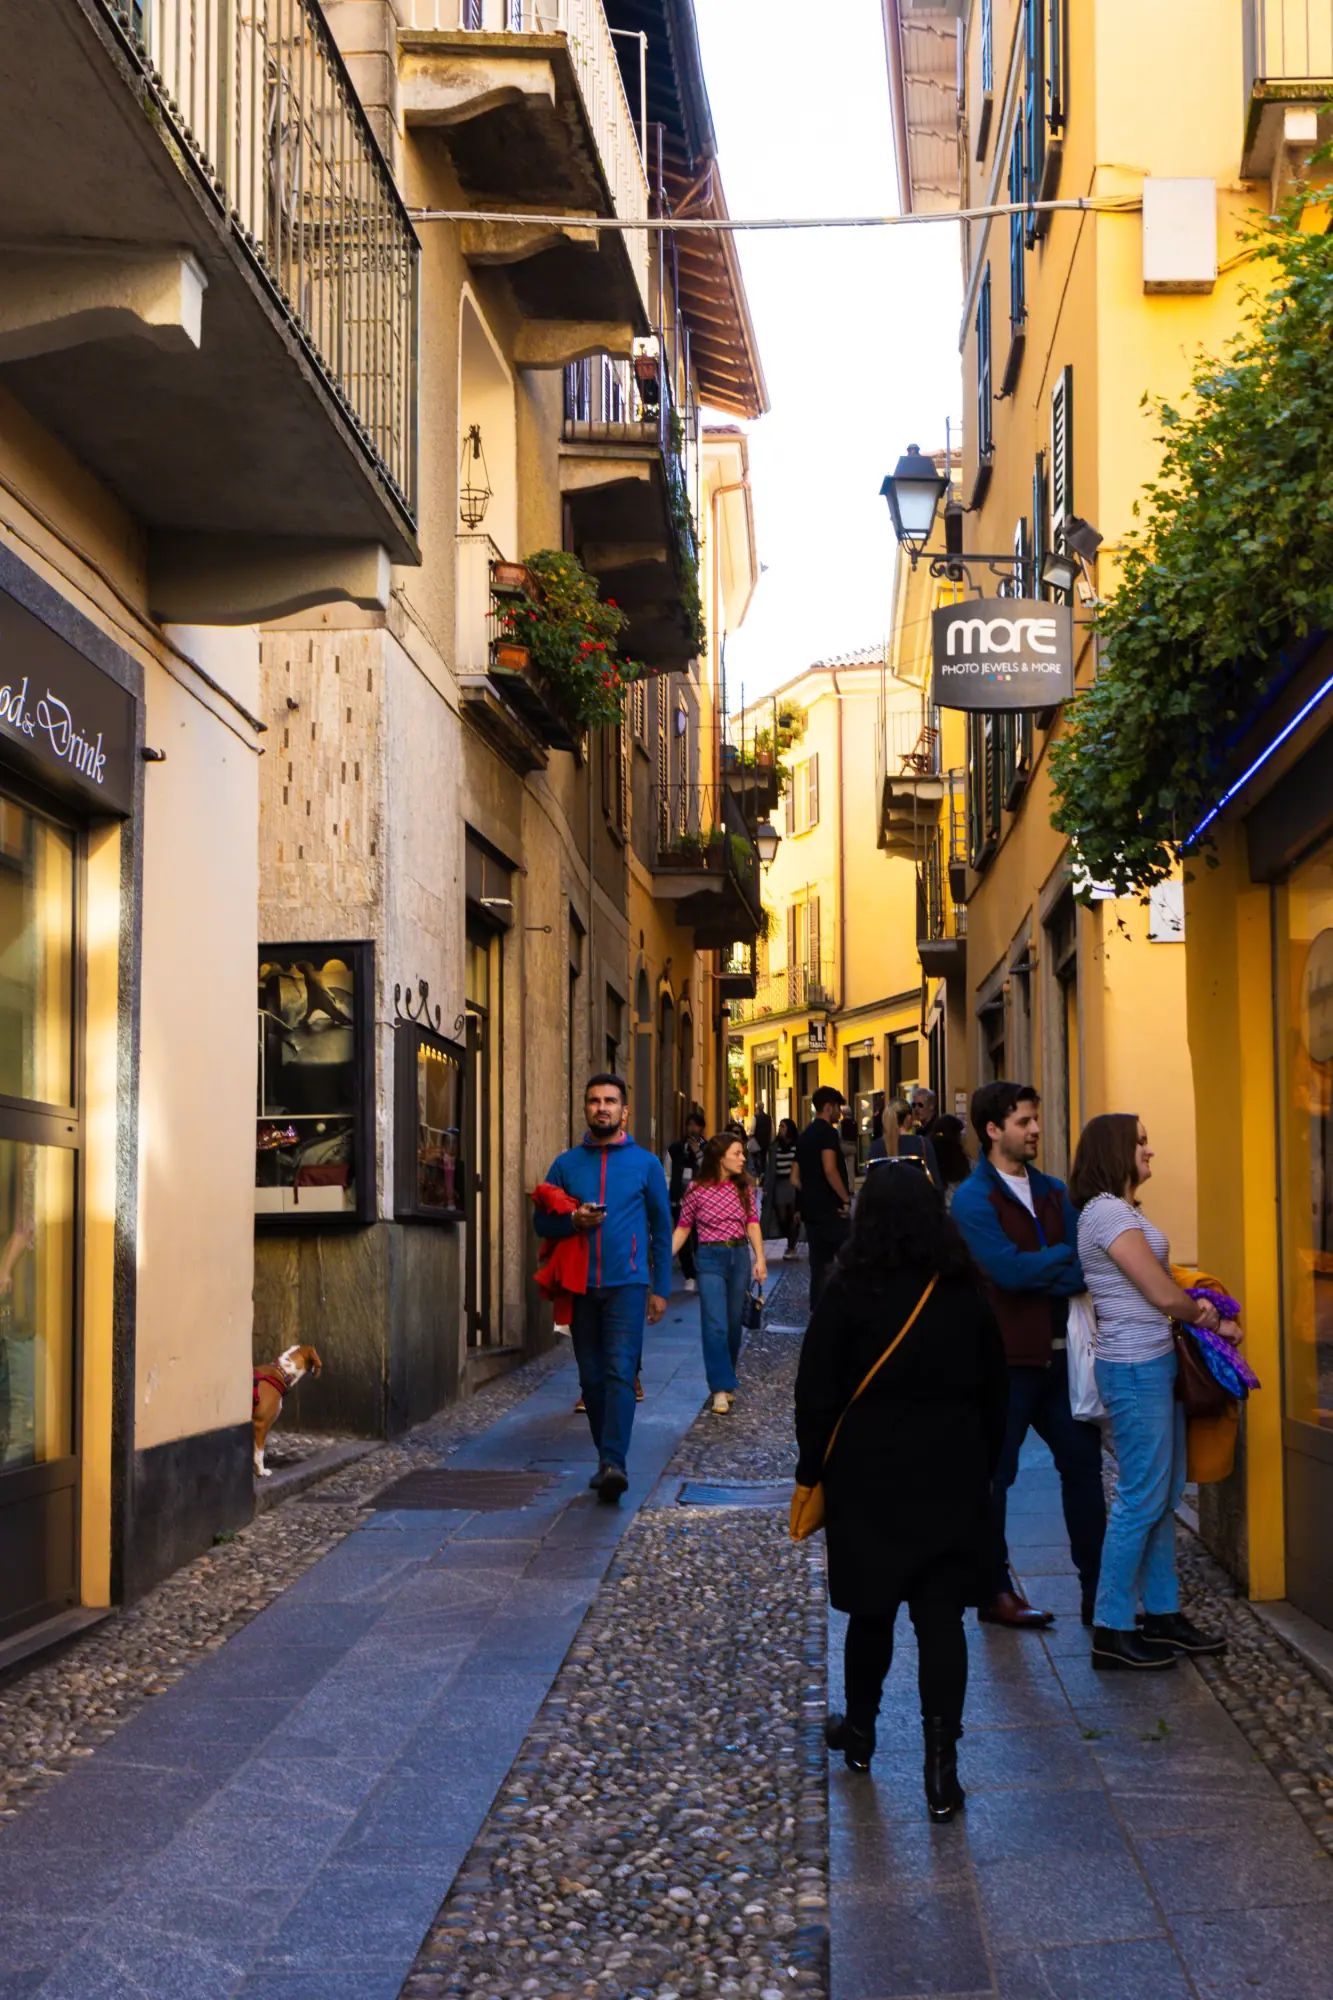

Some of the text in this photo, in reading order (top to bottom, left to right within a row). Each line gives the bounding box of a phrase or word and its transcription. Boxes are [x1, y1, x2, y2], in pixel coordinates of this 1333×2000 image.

[941, 662, 1062, 675] PHOTO JEWELS & MORE
[22, 712, 36, 738] &
[37, 688, 106, 784] Drink
